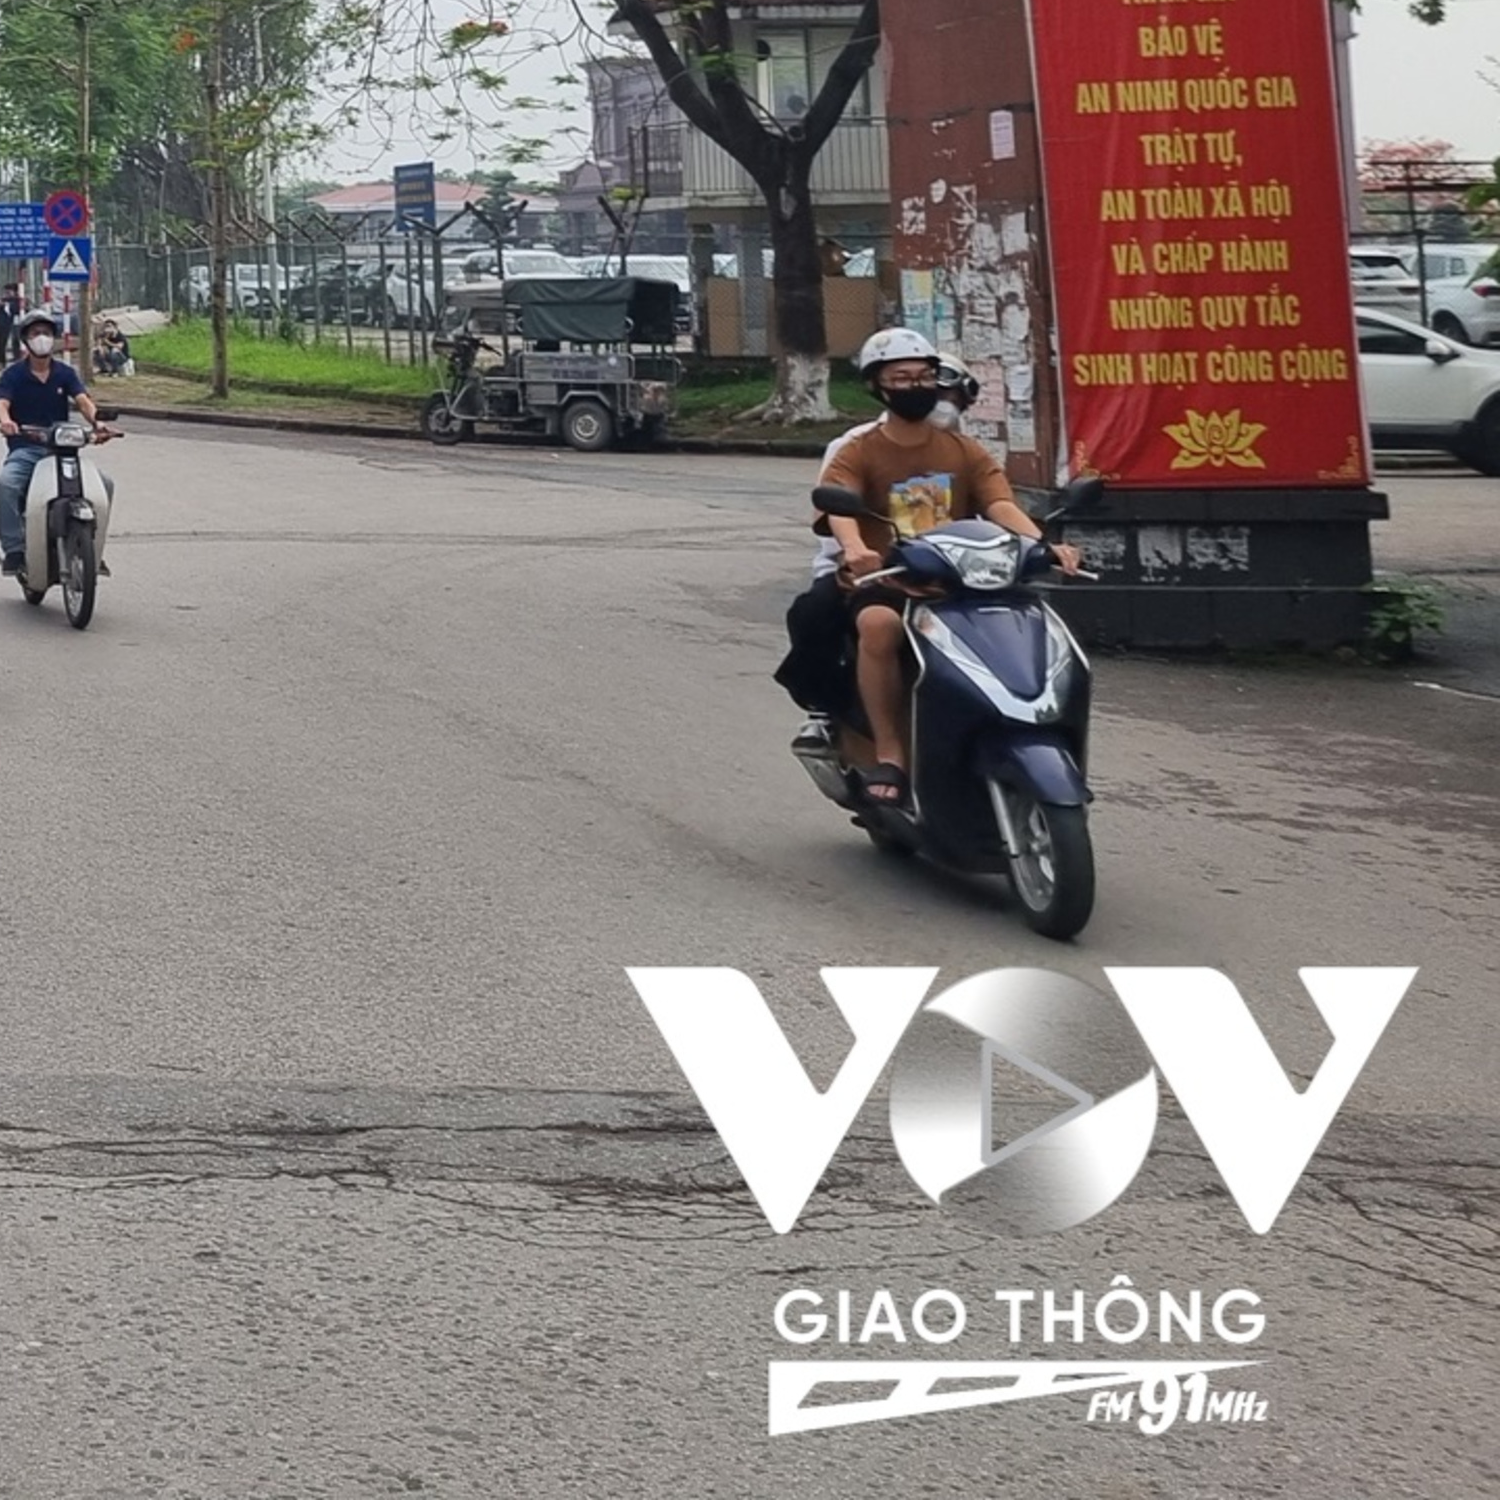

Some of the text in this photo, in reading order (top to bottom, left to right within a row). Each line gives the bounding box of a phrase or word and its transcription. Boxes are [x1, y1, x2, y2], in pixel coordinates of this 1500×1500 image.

[1138, 15, 1224, 62] BẢO VỆ
[1076, 66, 1296, 114] AN NINH QUỐC GIA
[1139, 128, 1243, 171] TRẬT TỰ,
[1101, 178, 1292, 223] AN TOÀN XÃ HỘI
[1112, 231, 1289, 276] VÀ CHẤP HÀNH
[1110, 284, 1300, 330] NHỮNG QUY TẮC
[1074, 344, 1348, 391] SINH HOẠT CÔNG CỘNG
